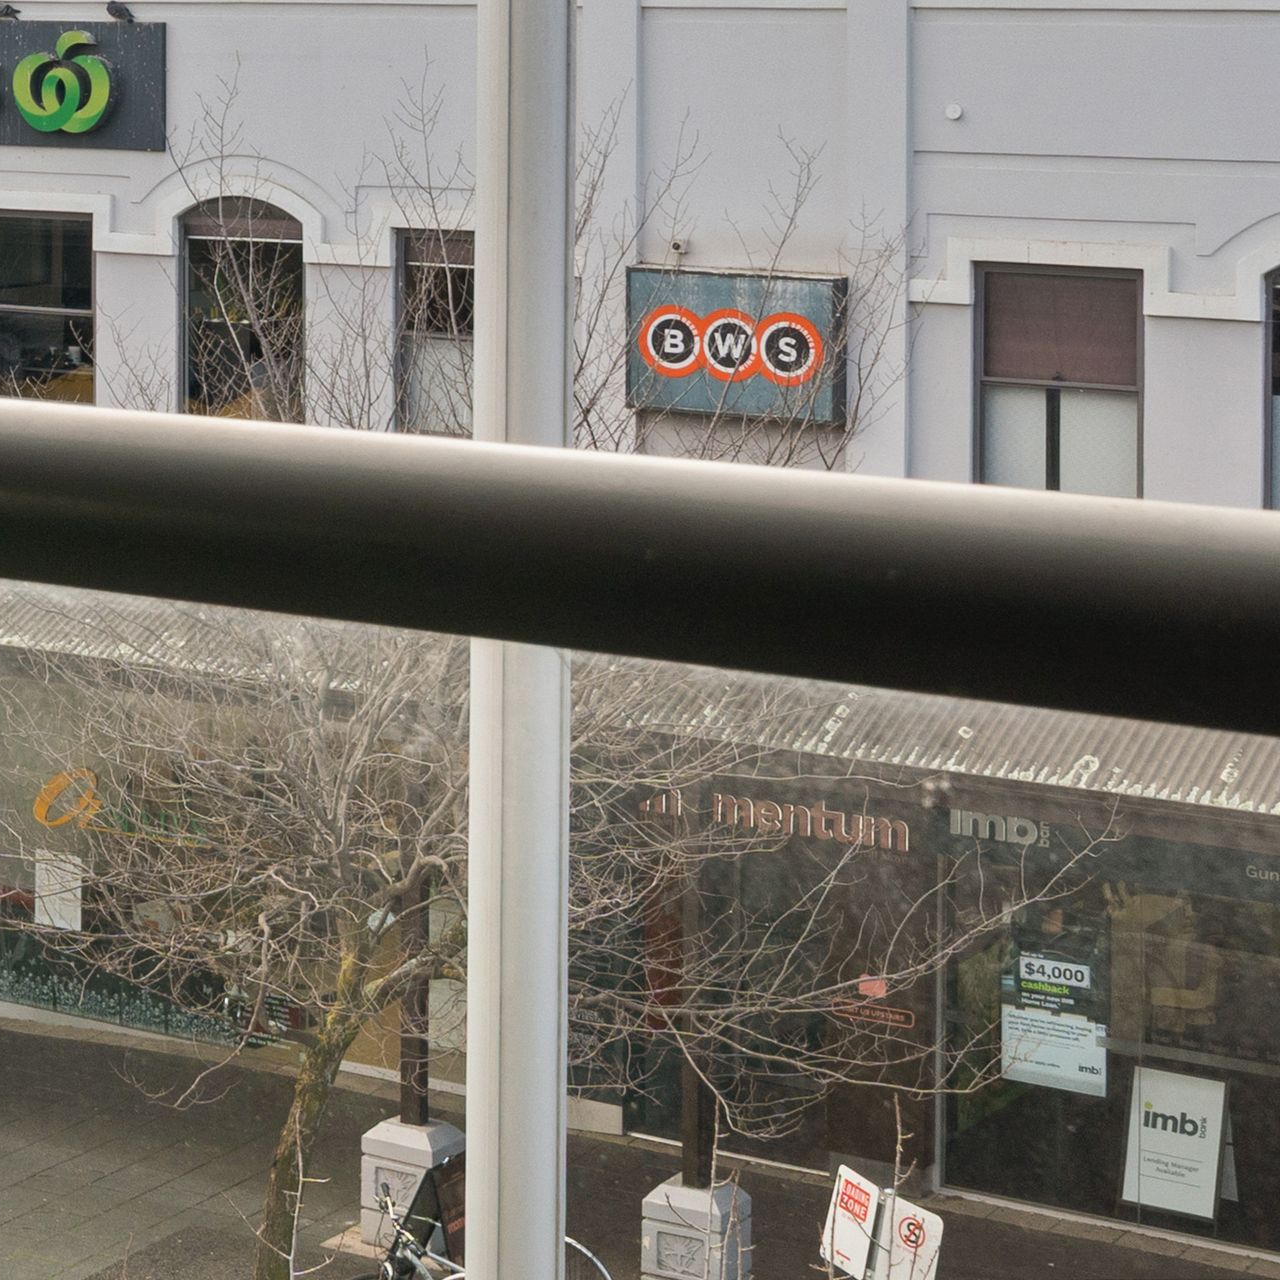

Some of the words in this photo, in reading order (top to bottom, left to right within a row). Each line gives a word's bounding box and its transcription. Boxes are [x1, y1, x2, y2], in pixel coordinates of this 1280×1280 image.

[640, 789, 910, 853] mmentum
[1038, 820, 1050, 848] ban
[1246, 865, 1280, 881] Gun
[1024, 961, 1085, 983] $4,000
[1021, 980, 1070, 995] cashback
[1078, 1064, 1099, 1075] imb
[1143, 1101, 1199, 1137] imb
[840, 1194, 868, 1219] ZONE
